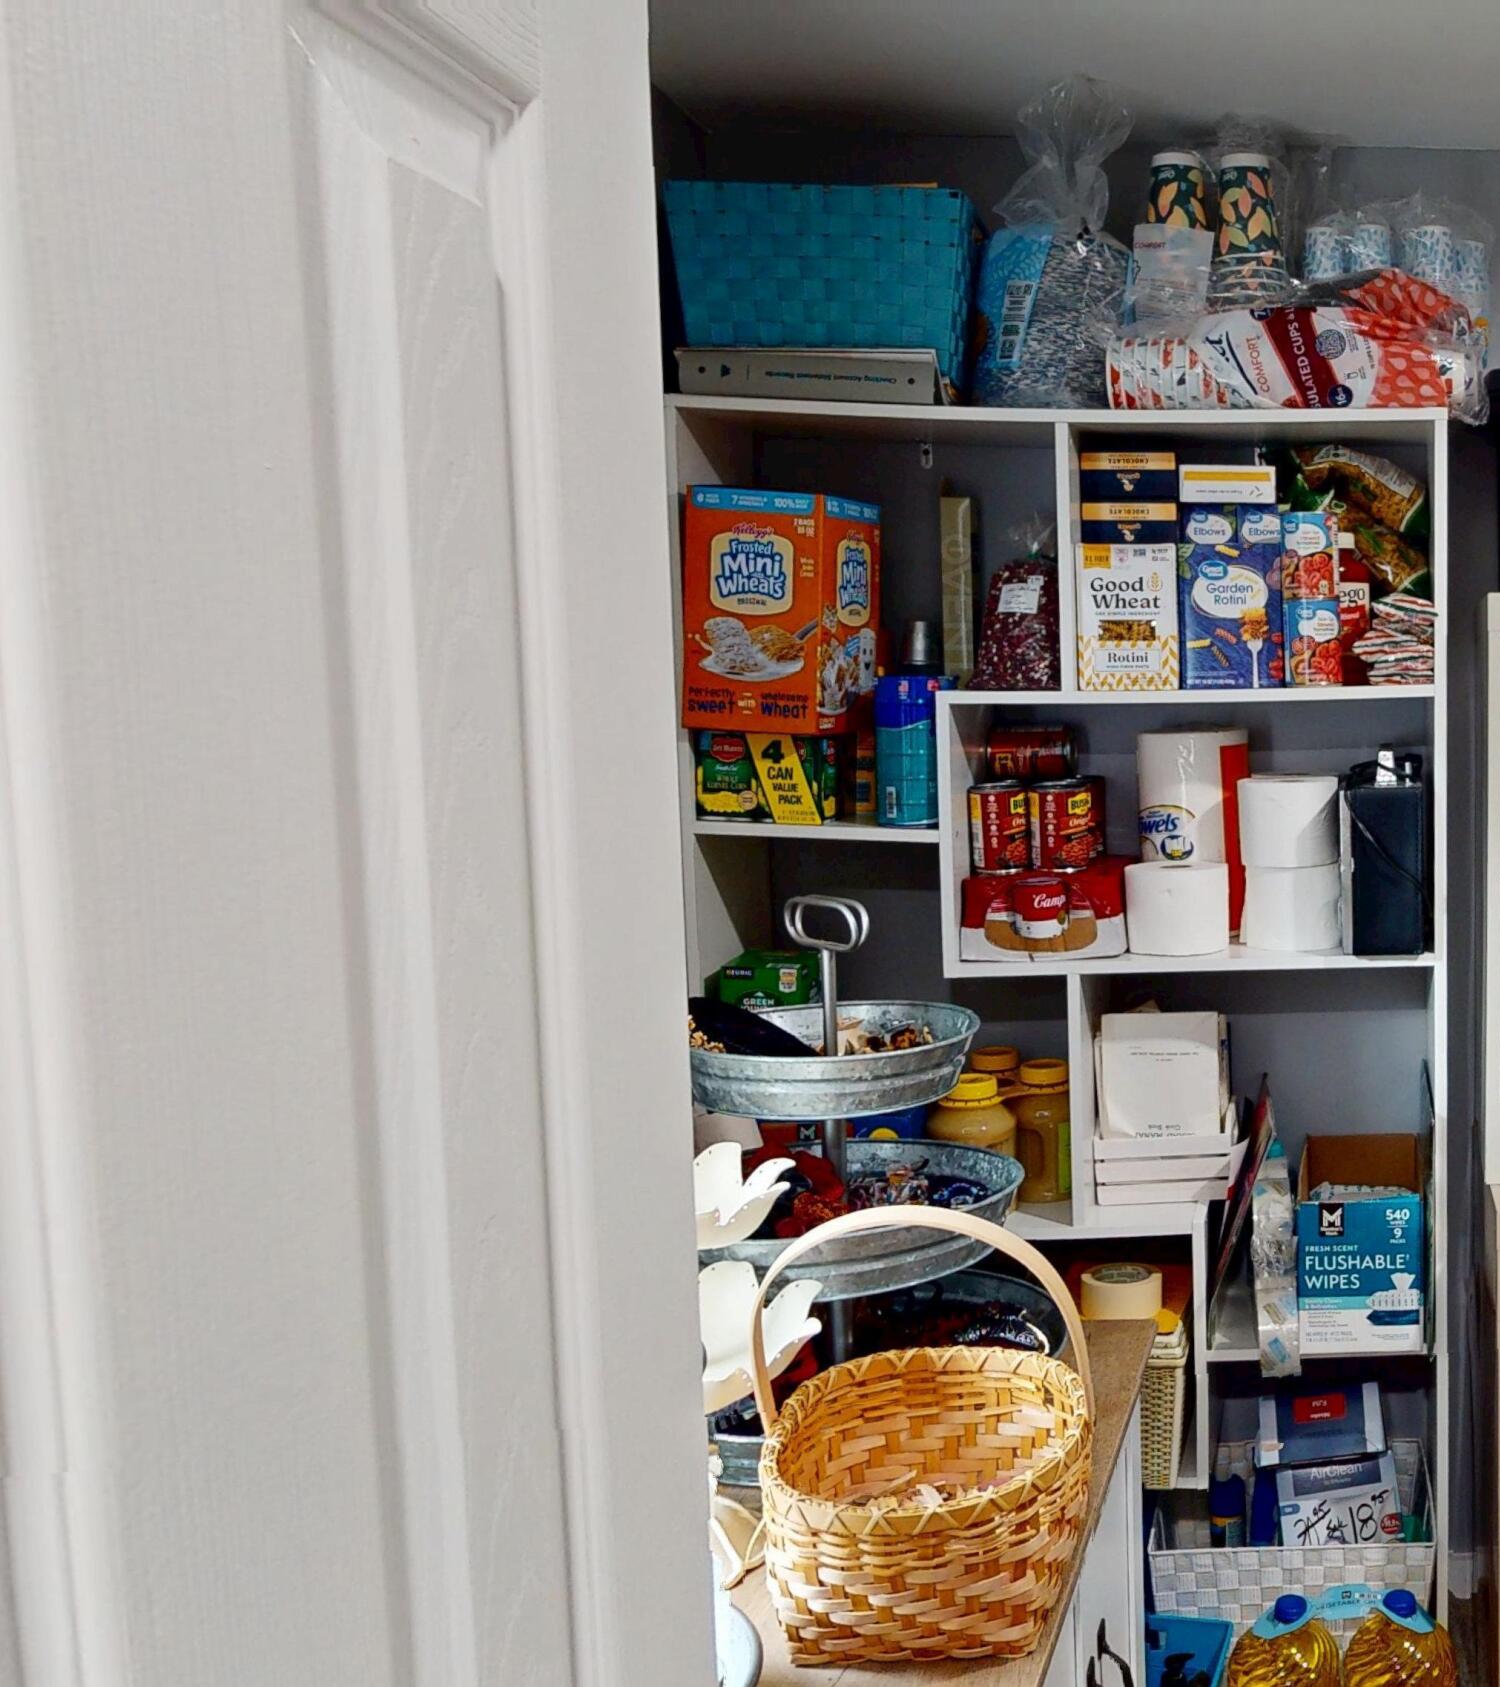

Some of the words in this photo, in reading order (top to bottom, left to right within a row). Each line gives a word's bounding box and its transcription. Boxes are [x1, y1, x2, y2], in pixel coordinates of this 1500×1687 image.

[1287, 322, 1305, 354] CUPS
[1246, 336, 1271, 393] COMFORT
[731, 522, 775, 539] Kellogg's
[1193, 526, 1226, 536] Elbows
[730, 539, 773, 555] Frosted
[723, 553, 782, 577] Mini
[843, 562, 867, 585] Mini
[716, 574, 785, 598] Wheats
[1090, 576, 1144, 592] Good
[1206, 582, 1254, 594] Garden
[1091, 593, 1161, 609] Wheat
[1214, 594, 1247, 606] Rotini
[1339, 588, 1366, 607] ego
[1107, 652, 1149, 663] Rotini
[761, 739, 785, 764] 4
[767, 766, 794, 780] CAN
[772, 782, 799, 792] VALUE
[778, 794, 803, 805] PACK
[743, 997, 775, 1006] GREEN
[1385, 1208, 1411, 1220] 540
[1393, 1228, 1403, 1238] 9
[1332, 1244, 1359, 1252] SCENT
[1304, 1274, 1360, 1289] WIPES
[1310, 1462, 1364, 1480] AirClean
[1348, 1503, 1378, 1544] 18
